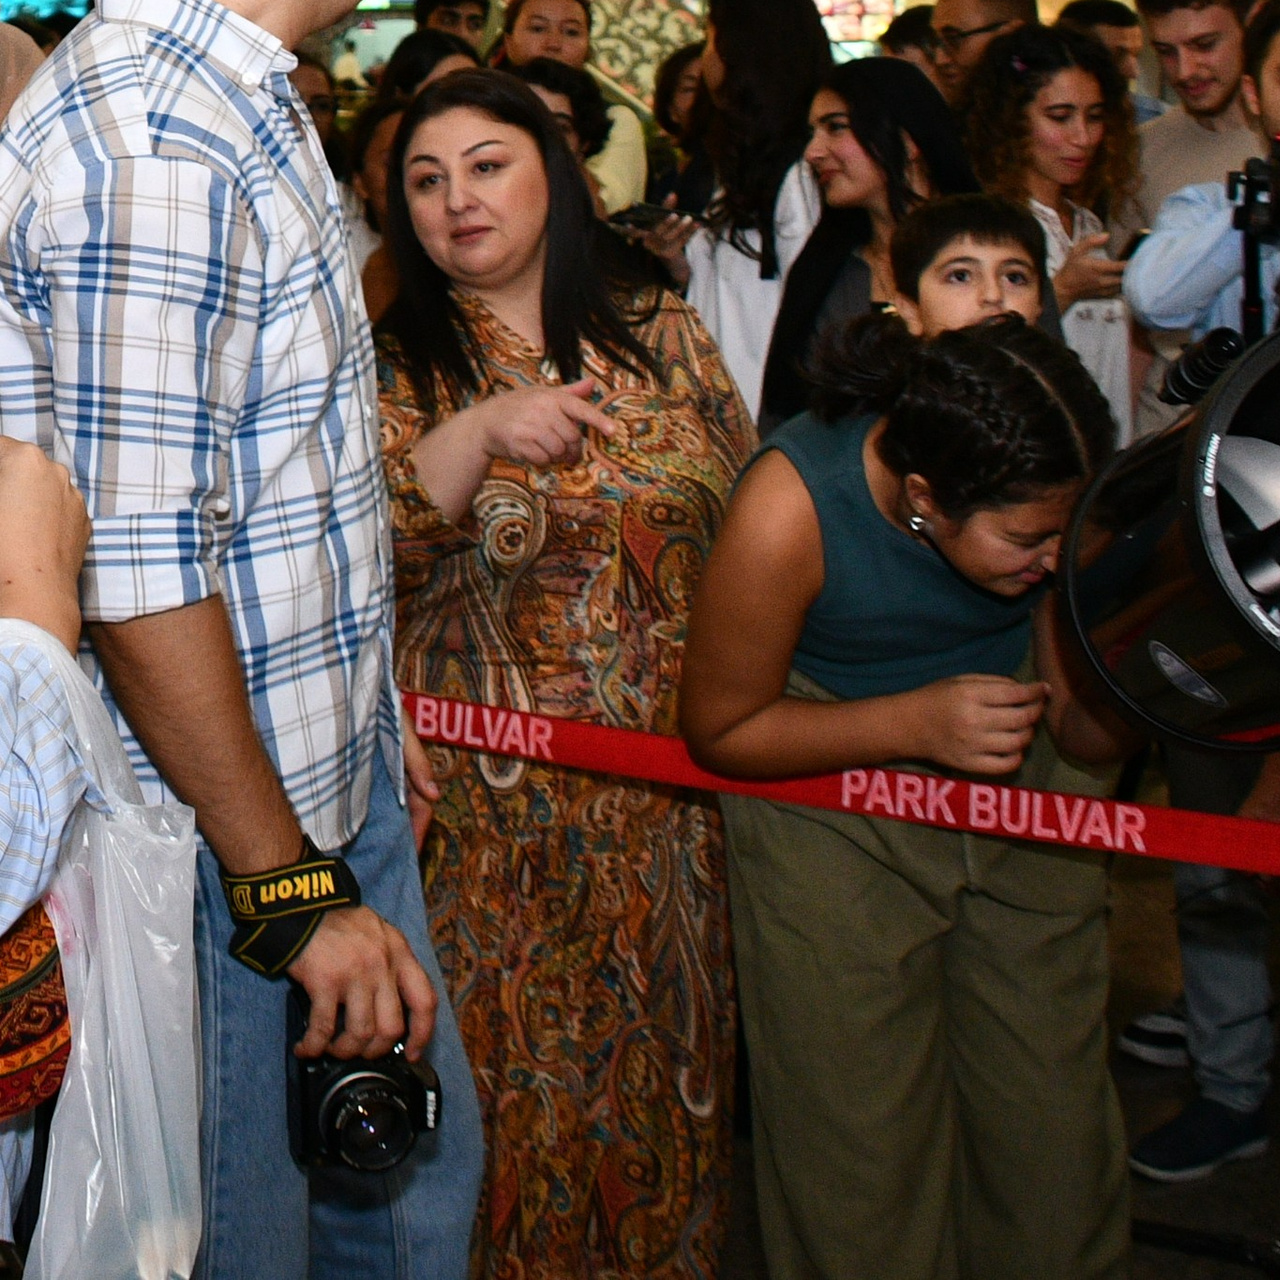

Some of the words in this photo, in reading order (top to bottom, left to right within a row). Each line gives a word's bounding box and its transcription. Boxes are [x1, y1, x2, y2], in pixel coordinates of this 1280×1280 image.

[415, 696, 554, 760] BULVAR
[841, 768, 957, 824] PARK
[968, 782, 1147, 853] BULVAR
[259, 870, 335, 905] Nikon
